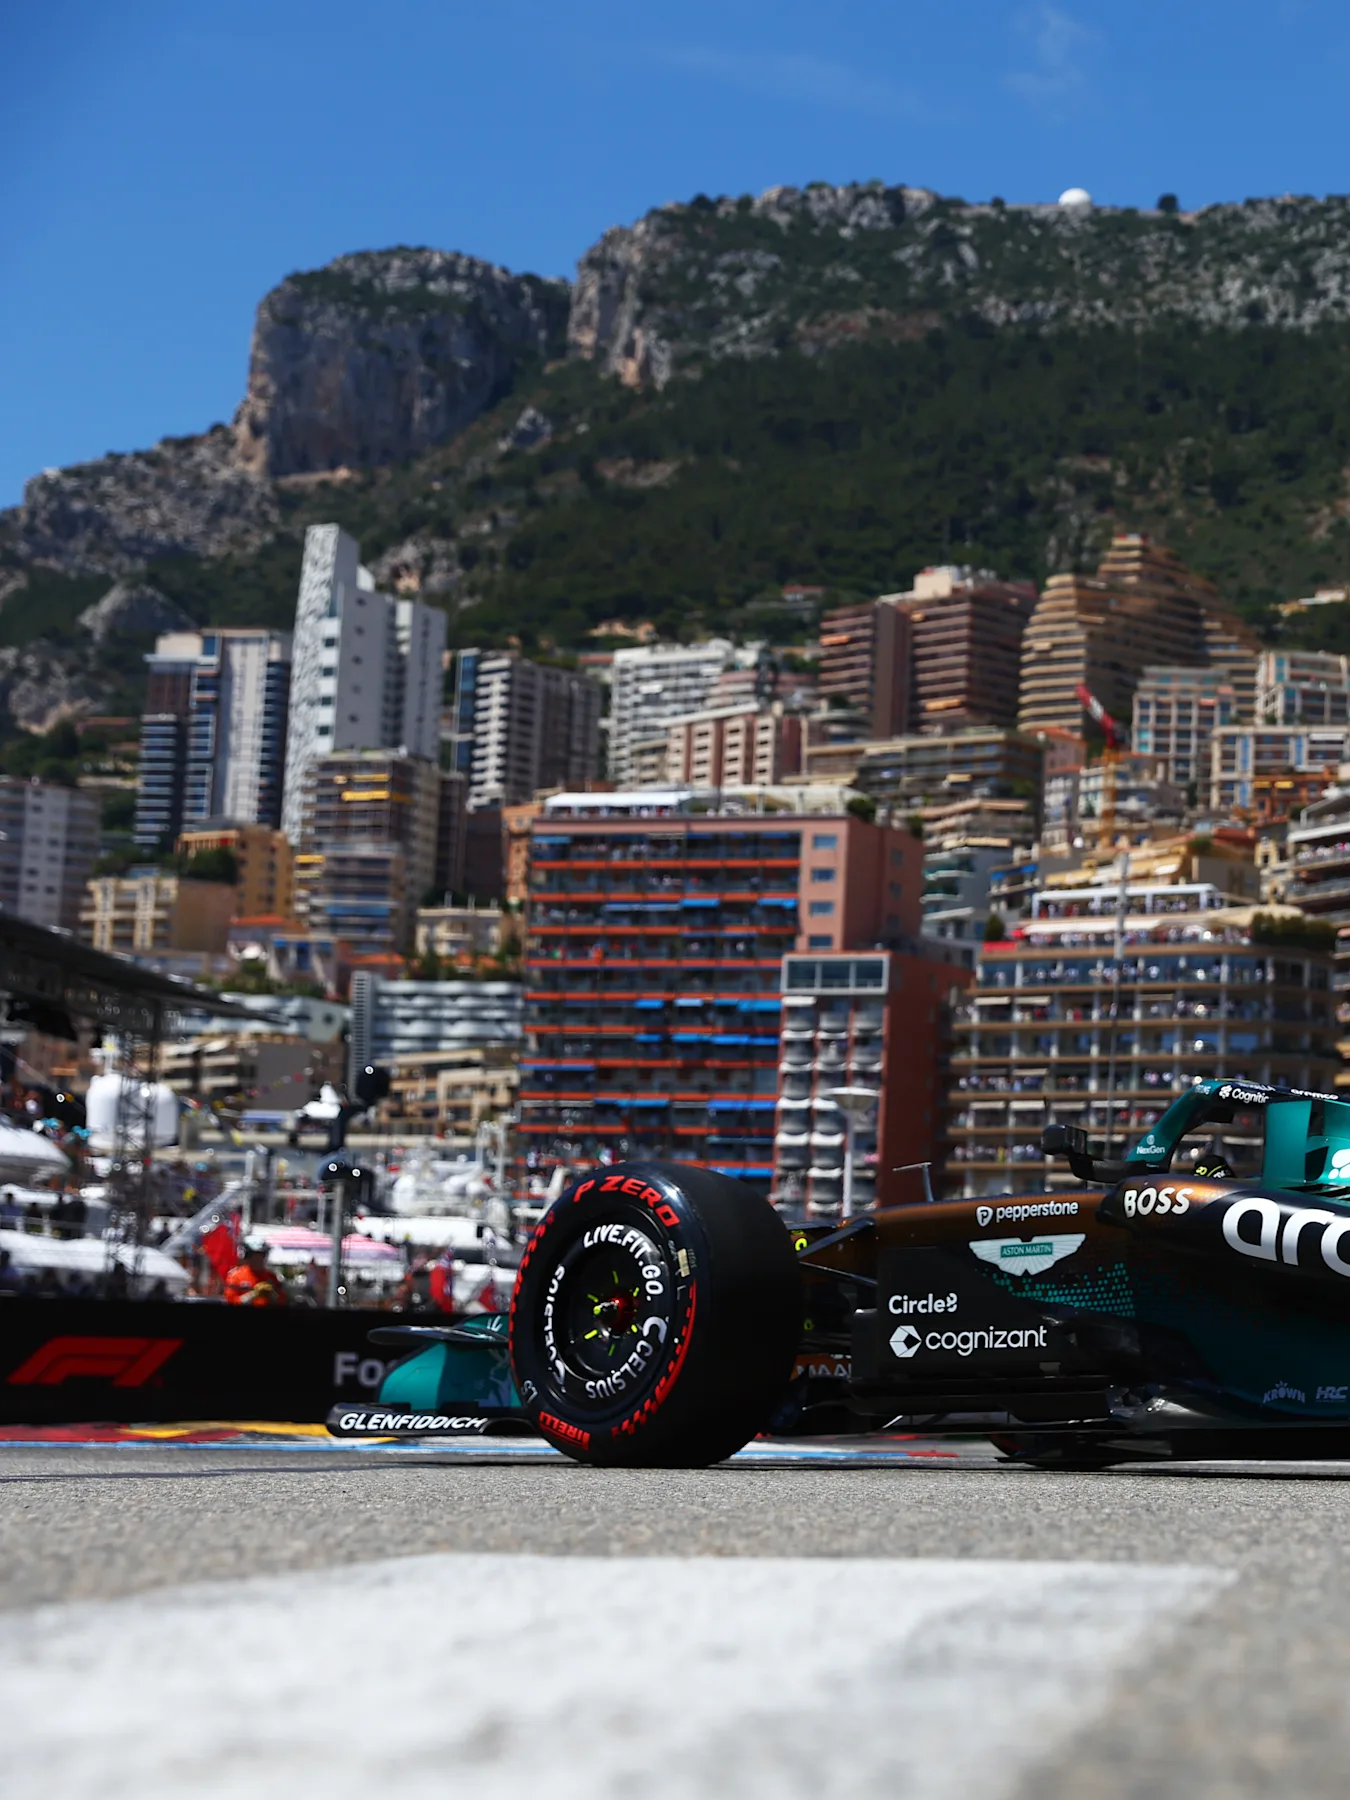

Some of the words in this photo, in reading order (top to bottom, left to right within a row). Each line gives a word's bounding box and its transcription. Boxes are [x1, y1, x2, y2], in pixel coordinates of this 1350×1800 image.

[573, 1179, 596, 1202] P
[599, 1175, 681, 1227] ZERO
[996, 1200, 1079, 1223] pepperstone
[1123, 1187, 1194, 1218] BOSS
[1002, 1245, 1024, 1256] ASTON
[1025, 1244, 1052, 1254] MARTIN
[925, 1325, 1047, 1356] cognizant
[1315, 1386, 1348, 1399] HRC
[339, 1412, 488, 1433] GLENFIDDICH
[539, 1410, 591, 1450] PIRELLI
